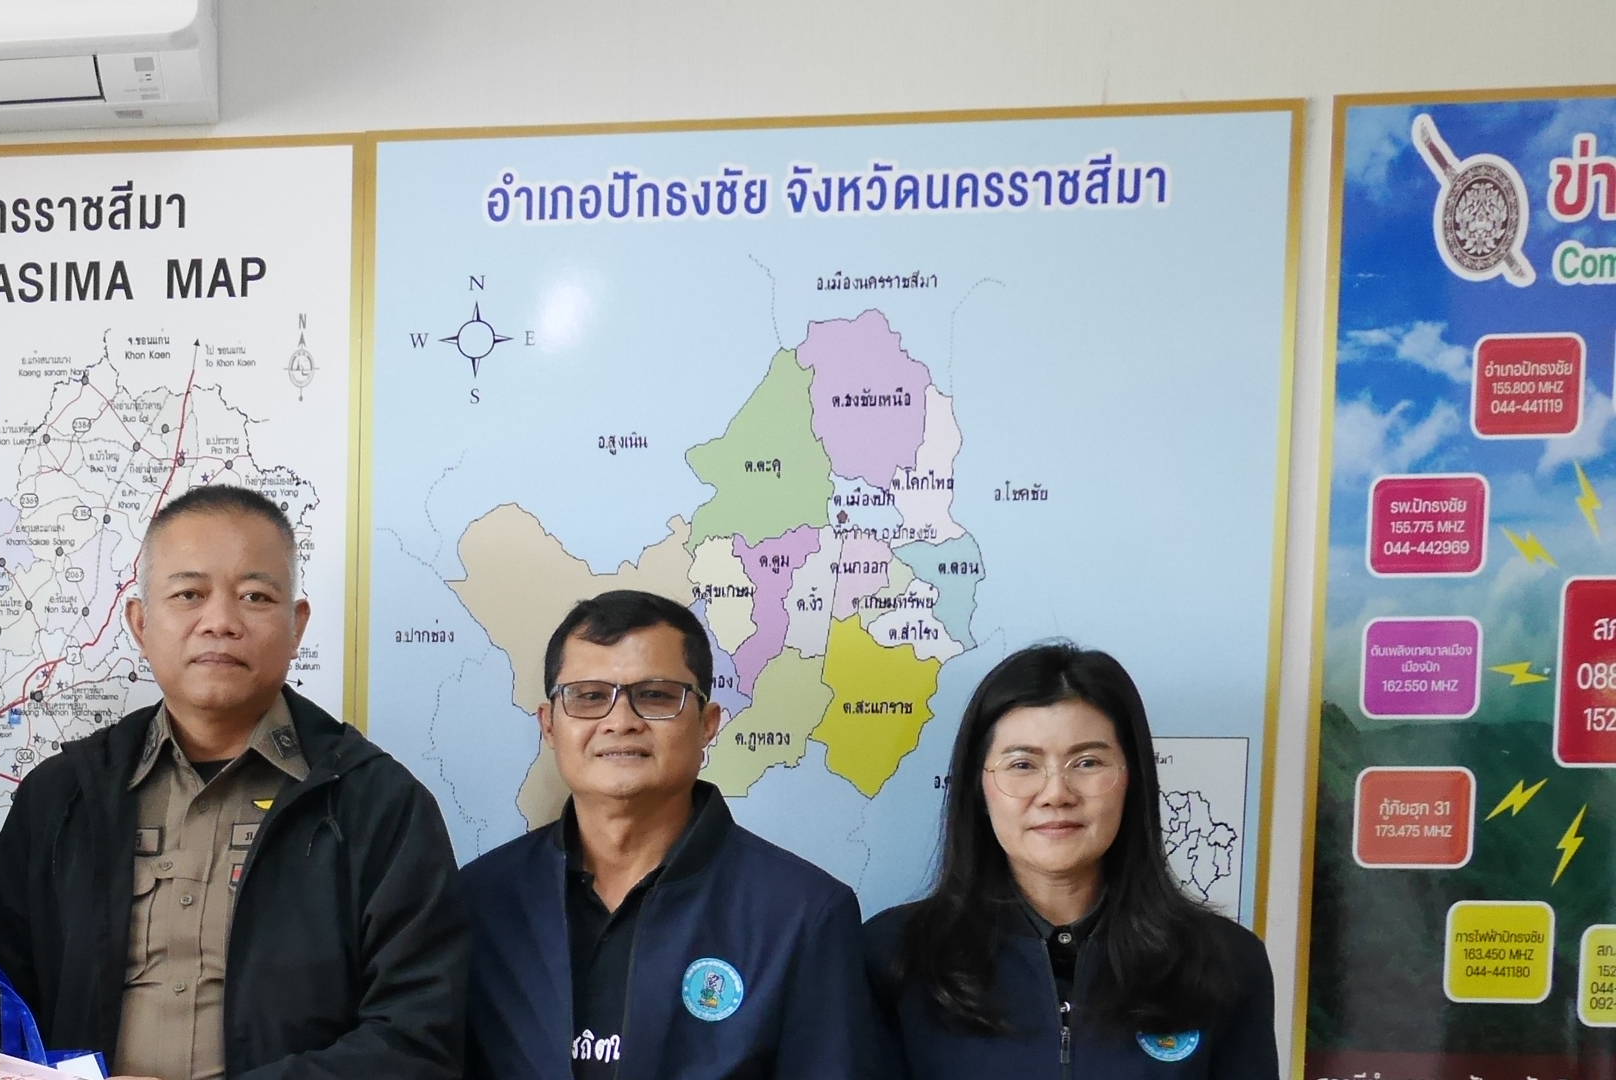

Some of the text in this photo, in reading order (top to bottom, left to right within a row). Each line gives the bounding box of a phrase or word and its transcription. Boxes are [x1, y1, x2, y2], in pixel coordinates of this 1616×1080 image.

[486, 155, 1168, 224] อำเภอปักธงชัย จังหวัดนครราชสีมา
[165, 257, 267, 300] MAP
[468, 275, 486, 291] N
[299, 313, 307, 329] N
[410, 334, 429, 349] W
[524, 332, 536, 346] E
[125, 351, 170, 360] Khon Kaen
[216, 359, 256, 367] Khon Kaen
[1485, 362, 1573, 378] อำเภอปักธงชัย
[19, 368, 89, 378] Kaeng sanam Nang
[1492, 381, 1563, 395] 155.800 MHZ
[469, 389, 480, 405] S
[1491, 399, 1562, 414] 044-441119
[280, 488, 298, 498] Yang
[118, 500, 140, 511] Khong
[1390, 498, 1467, 514] รพ.ปักธงชัย
[1390, 520, 1465, 534] 155.775 MHZ
[53, 539, 75, 548] Saeng
[1384, 541, 1469, 555] 044-442969
[62, 606, 78, 615] Sung
[395, 619, 454, 643] อ.ปากช่อง
[1382, 679, 1459, 692] 162.550 MHZ
[1583, 707, 1616, 731] 152
[1435, 801, 1450, 816] 31
[1375, 825, 1452, 838] 173.475 MHZ
[1463, 948, 1534, 961] 163.450 MHZ
[1465, 965, 1530, 978] 044-441180
